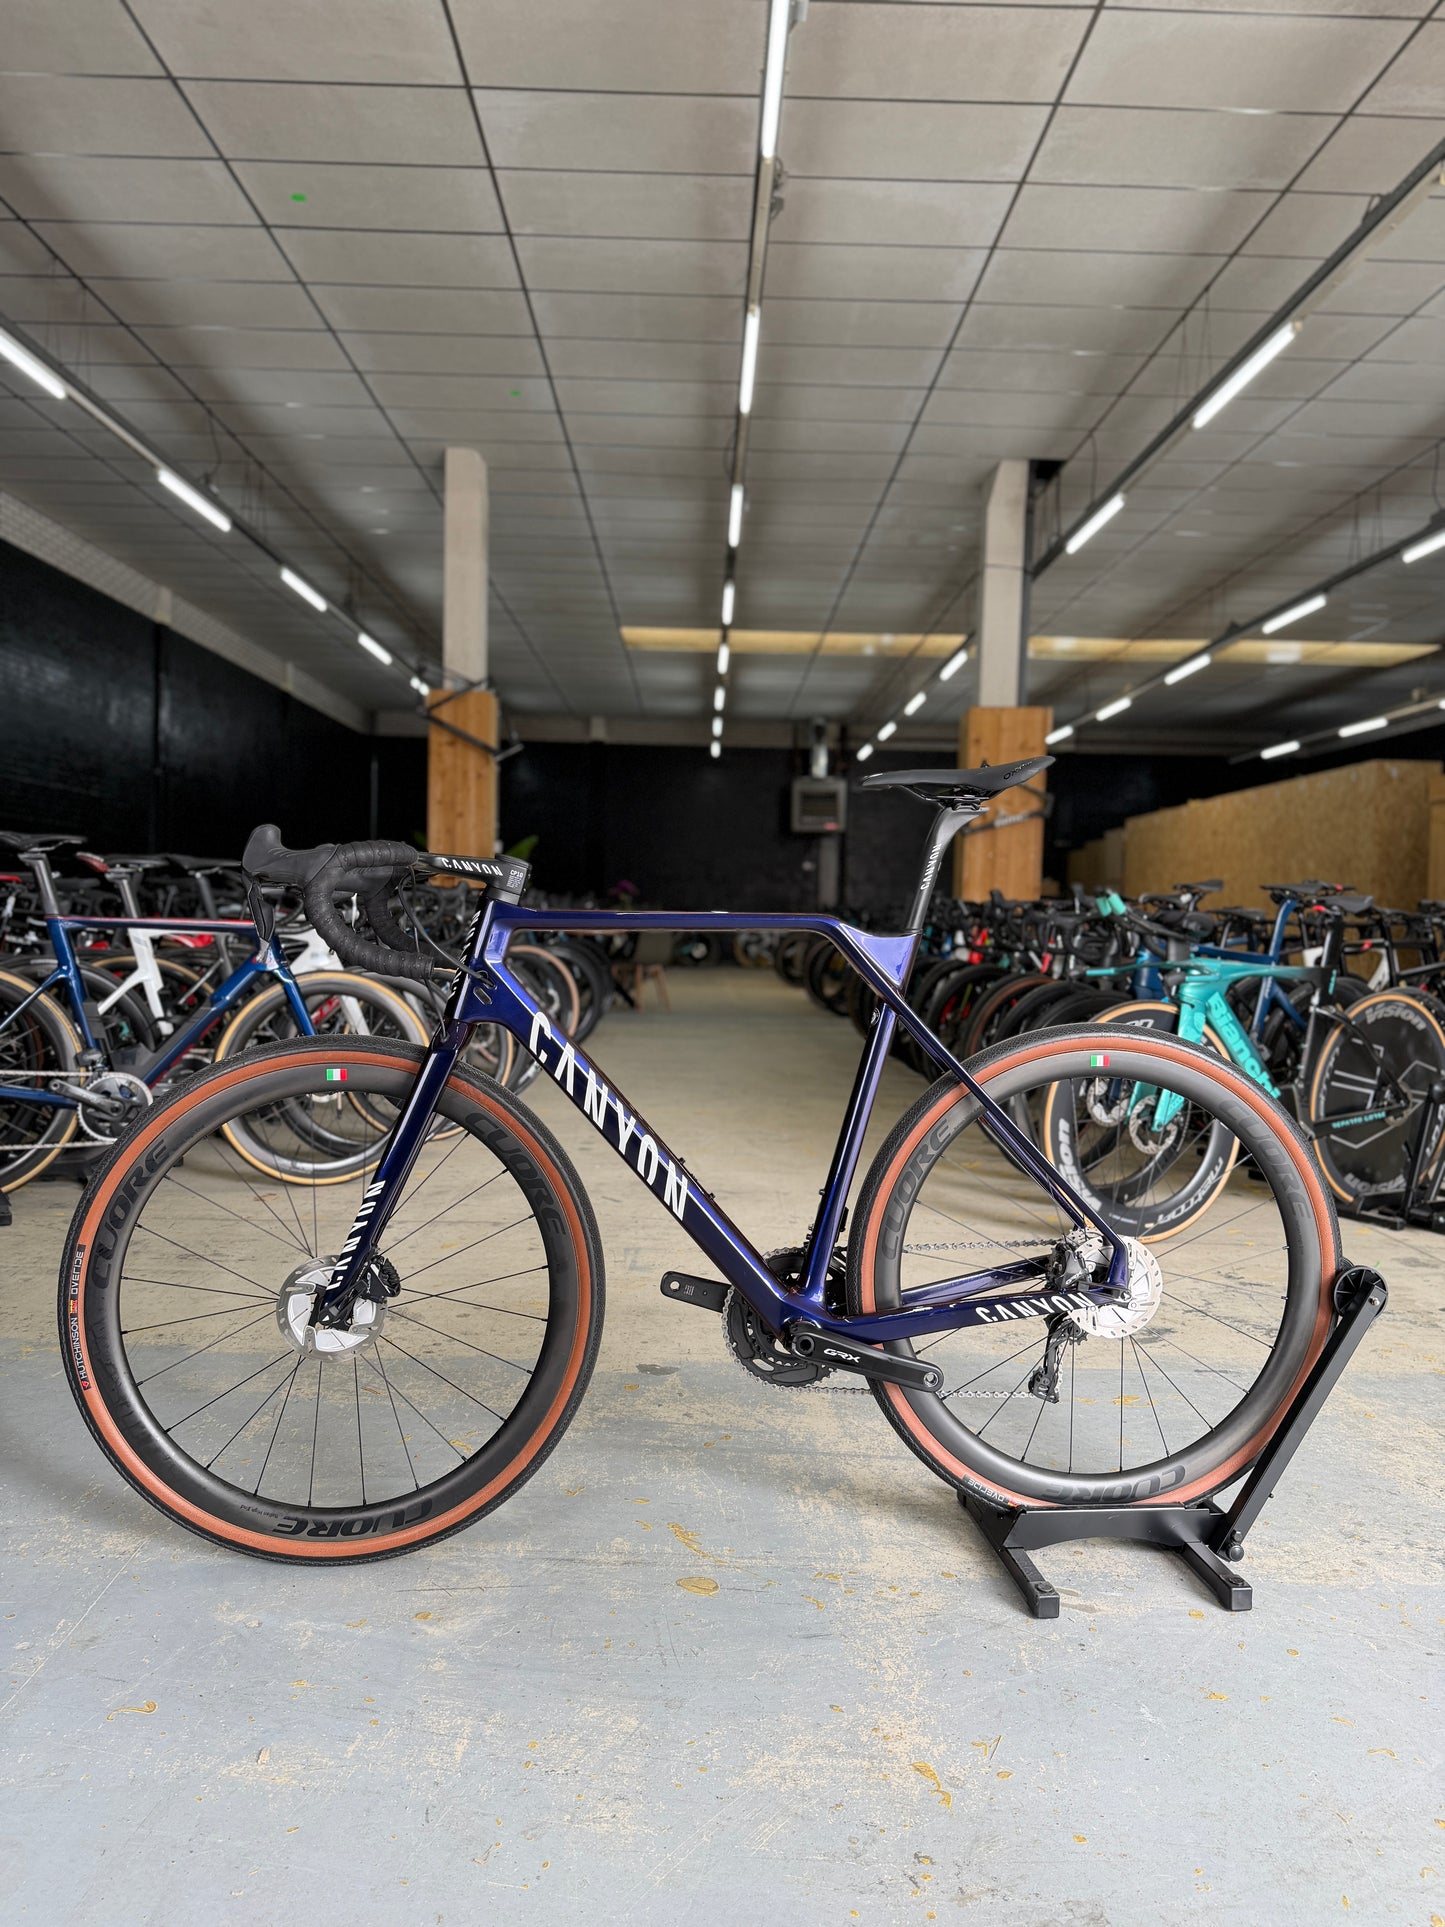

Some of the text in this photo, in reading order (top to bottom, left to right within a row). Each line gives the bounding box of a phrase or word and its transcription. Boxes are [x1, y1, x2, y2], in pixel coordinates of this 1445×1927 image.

[441, 857, 503, 876] CANYON
[920, 844, 942, 890] CANYON
[1364, 1003, 1427, 1031] Vision
[529, 1011, 688, 1222] CANYON
[464, 1112, 567, 1236] CUORE
[881, 1118, 951, 1260] CUORE
[1217, 1101, 1312, 1219] CUORE
[91, 1139, 169, 1290] CUORE
[325, 1180, 386, 1291] CANYON
[975, 1292, 1094, 1323] CANYON
[70, 1317, 88, 1380] HUTCHINSON
[823, 1347, 861, 1364] GRX
[272, 1498, 433, 1537] CUORE
